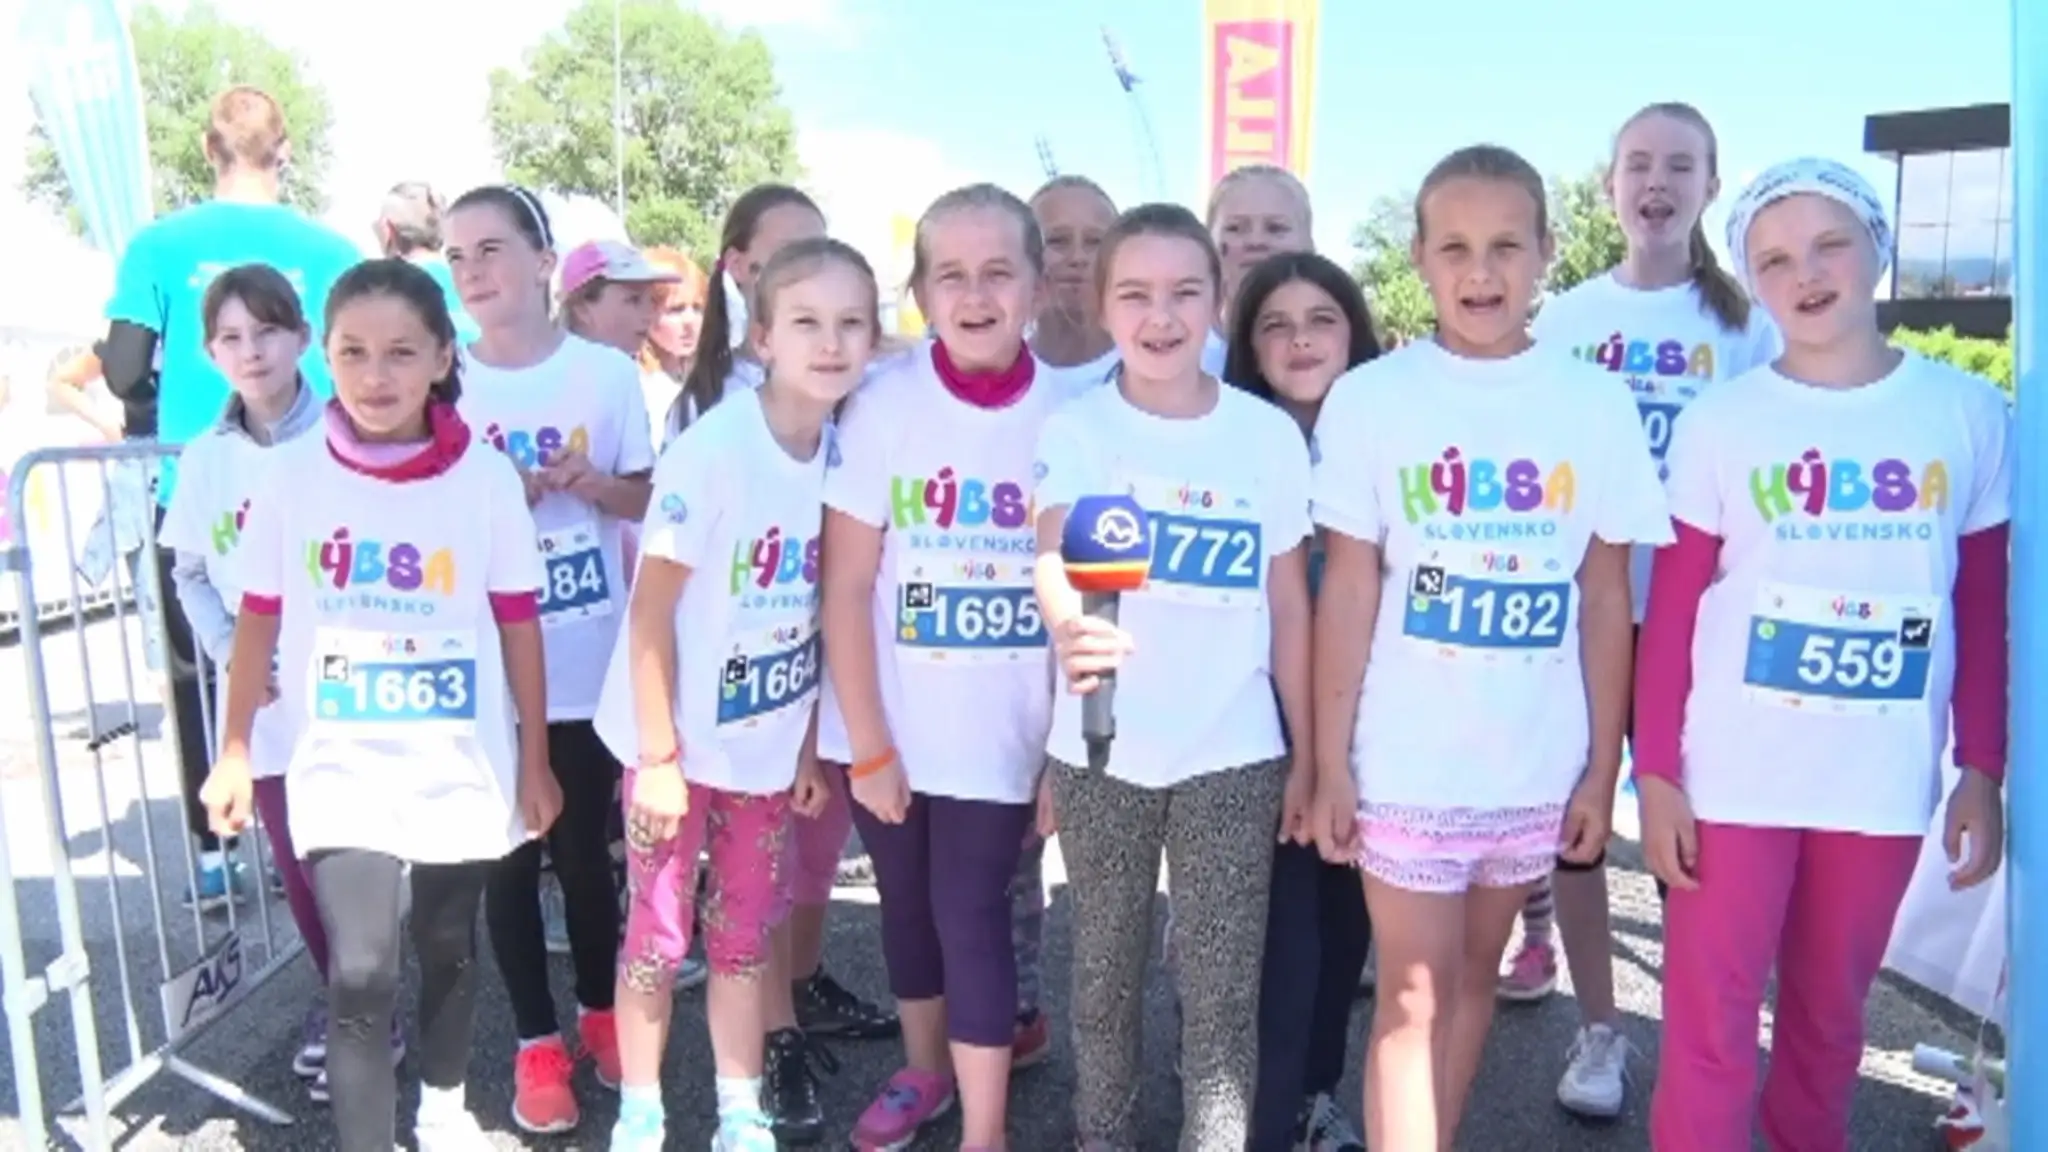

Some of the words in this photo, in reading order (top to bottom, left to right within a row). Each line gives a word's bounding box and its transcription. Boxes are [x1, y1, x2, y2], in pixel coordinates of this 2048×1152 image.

[891, 466, 1035, 529] HÝBS
[1399, 446, 1576, 524] HÝBSA
[1749, 447, 1948, 523] HÝBSA
[1424, 521, 1556, 540] SLOVENSKO
[1775, 522, 1932, 541] SLOVENSKO
[933, 594, 1042, 640] 1695
[1441, 586, 1560, 639] 1182
[746, 641, 817, 705] 1664
[1797, 634, 1903, 688] 559
[348, 667, 468, 713] 1663
